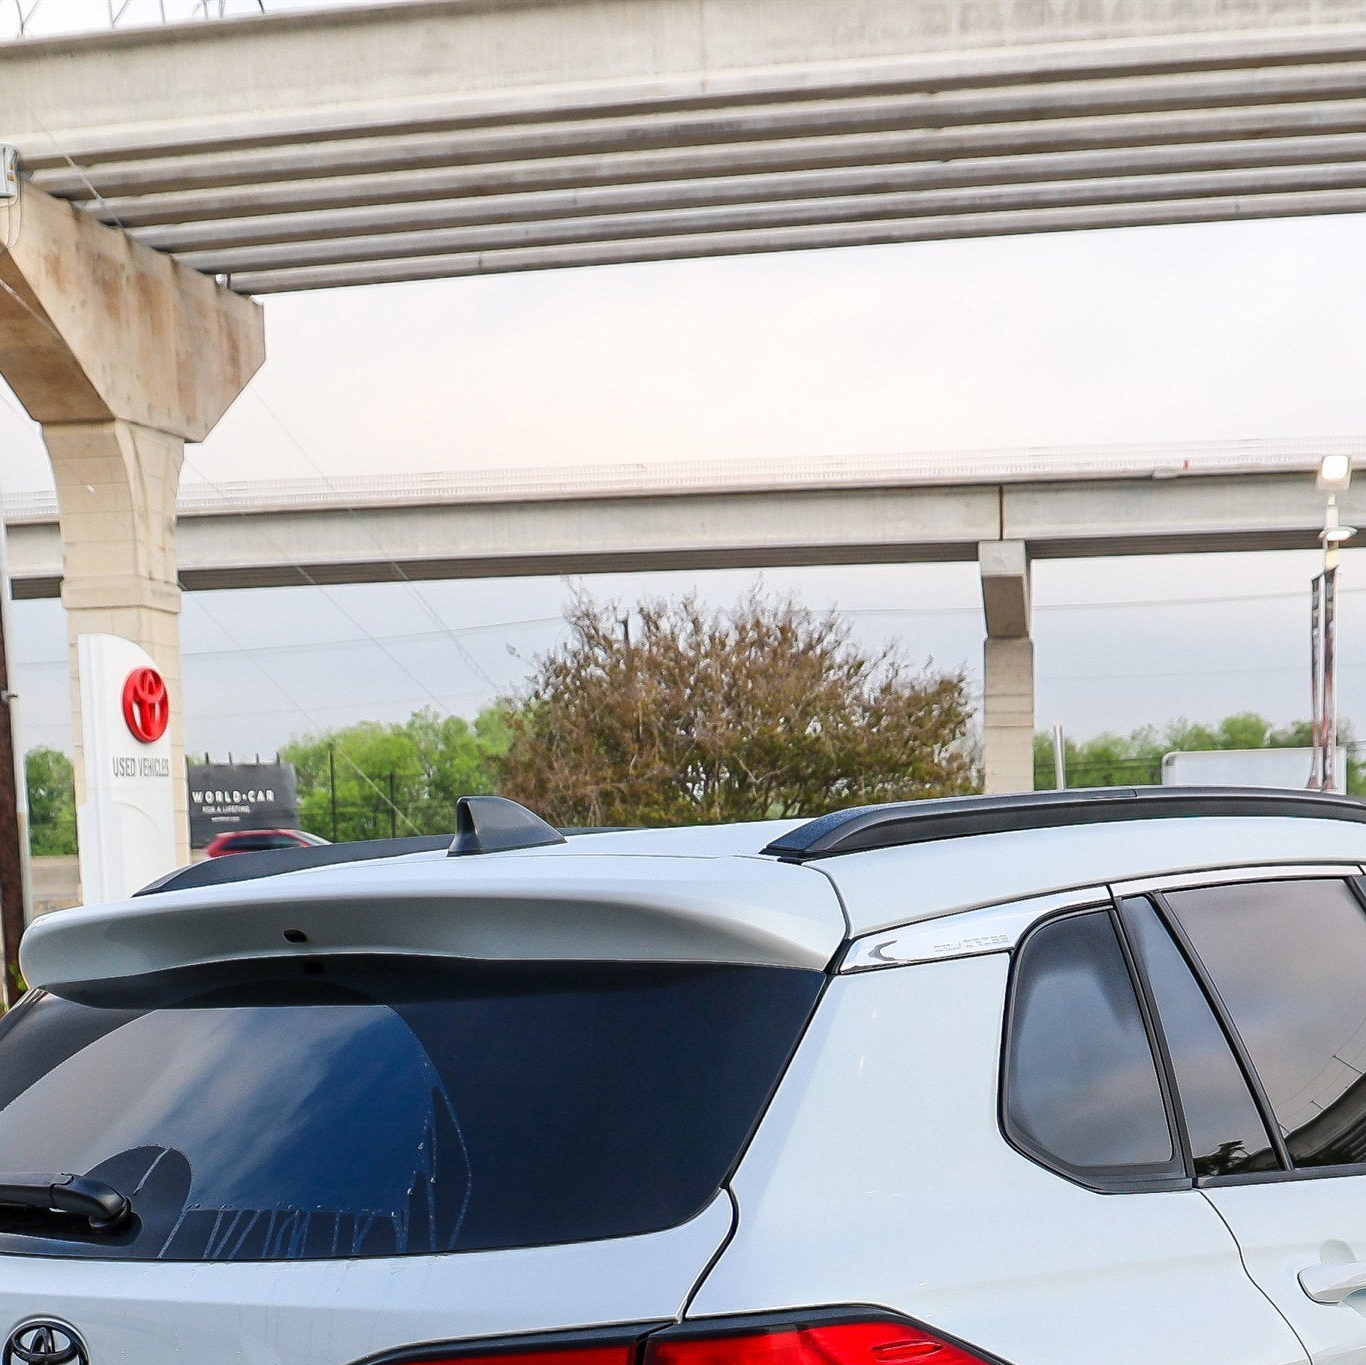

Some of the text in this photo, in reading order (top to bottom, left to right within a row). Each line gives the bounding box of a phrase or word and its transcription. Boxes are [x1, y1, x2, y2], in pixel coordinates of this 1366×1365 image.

[112, 756, 170, 778] USED VEHICLES
[191, 789, 275, 804] WORLD CAR
